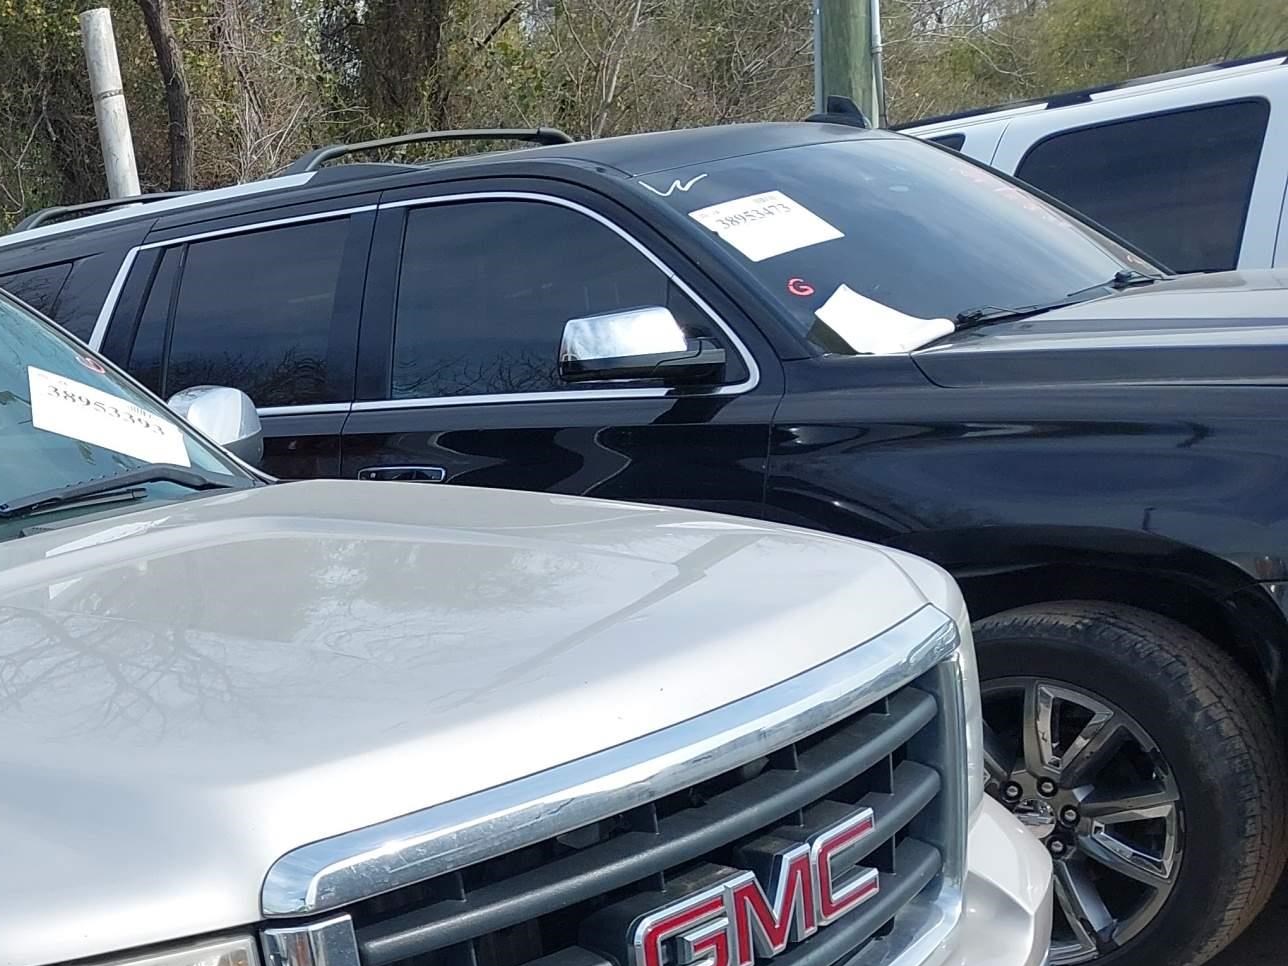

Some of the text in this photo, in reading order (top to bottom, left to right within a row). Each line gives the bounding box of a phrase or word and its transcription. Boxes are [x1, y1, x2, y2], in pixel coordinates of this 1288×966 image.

[715, 203, 793, 230] 38953473
[787, 277, 815, 297] G
[46, 384, 166, 436] 38953393
